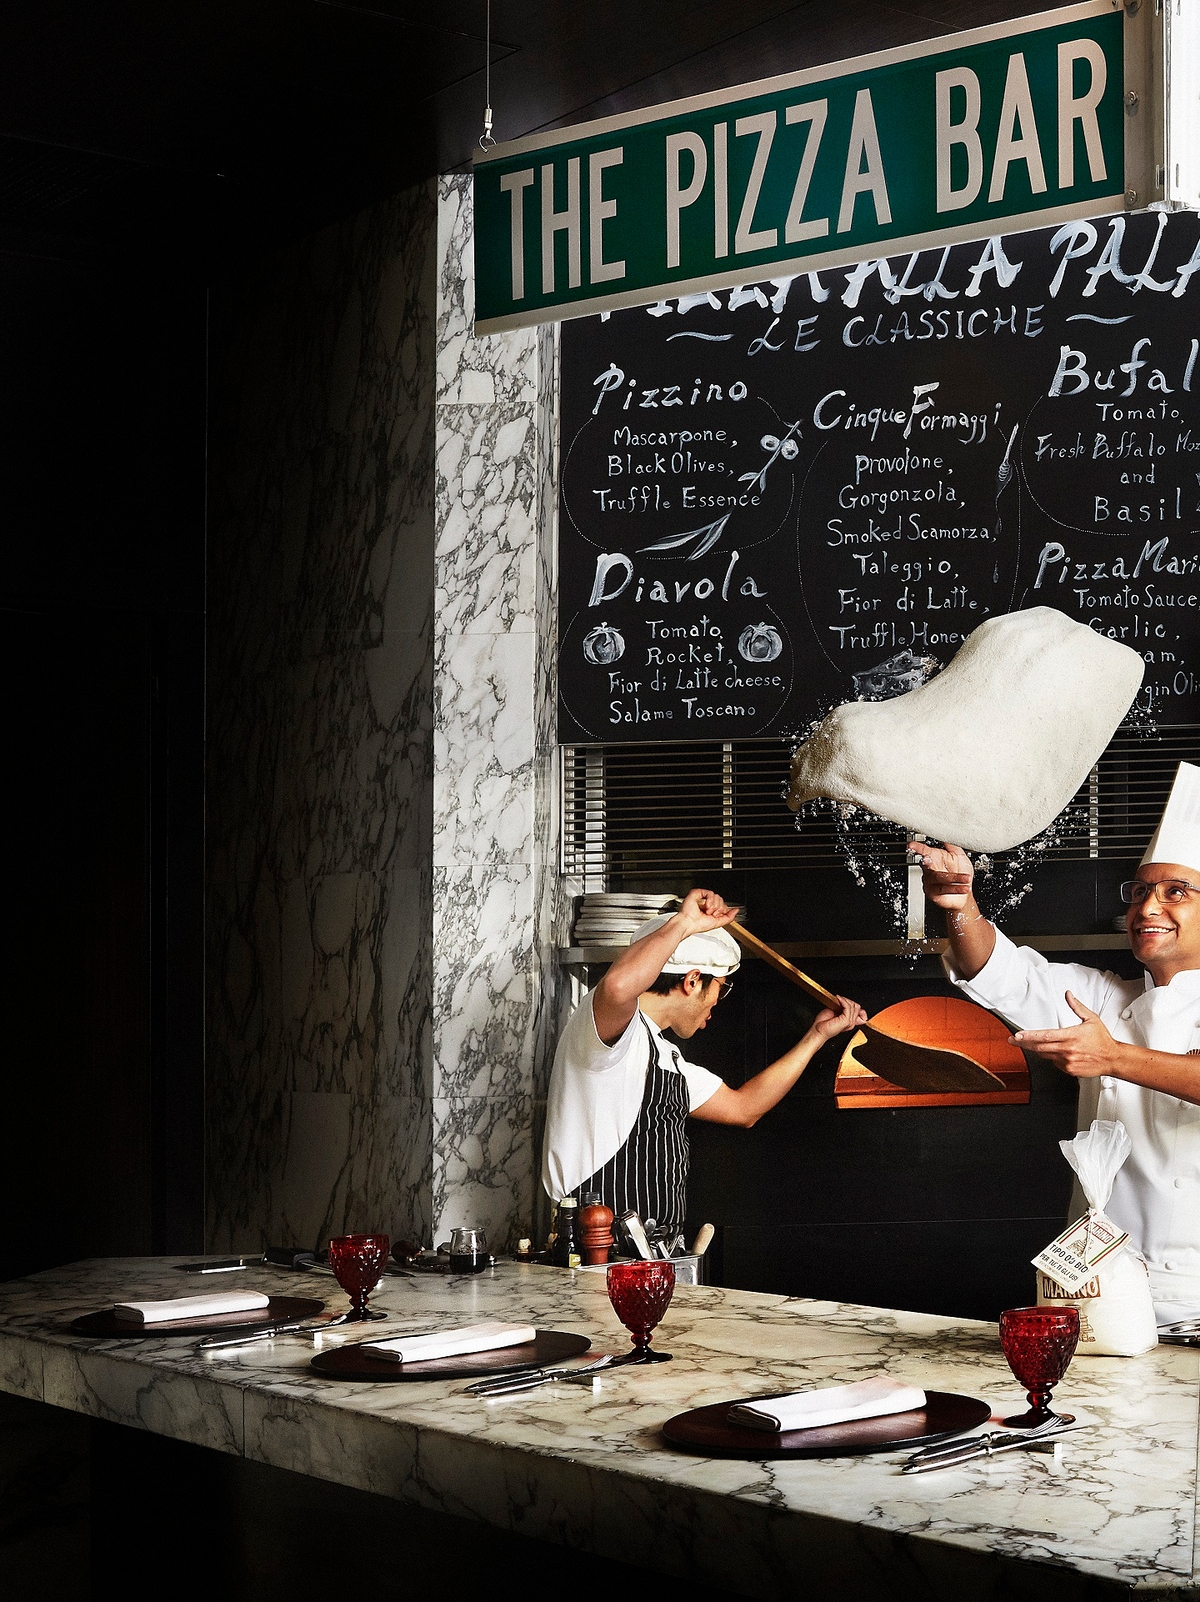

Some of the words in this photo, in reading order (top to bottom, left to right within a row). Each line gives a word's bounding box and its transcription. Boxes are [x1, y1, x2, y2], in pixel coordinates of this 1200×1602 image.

[500, 146, 626, 300] THE
[665, 88, 892, 269] PIZZA
[935, 38, 1107, 214] BAR
[747, 314, 821, 356] LE
[842, 304, 1045, 348] CLASSICHE
[592, 363, 748, 415] Pizzino
[1096, 400, 1185, 424] Tomato,
[613, 426, 738, 452] Mascarpone,
[1034, 432, 1086, 462] Fresh
[1091, 430, 1166, 461] Buffalo
[1120, 463, 1156, 485] and
[592, 486, 671, 513] Truffle
[683, 486, 762, 508] Essence
[838, 481, 966, 514] Gorgonzola,
[1094, 487, 1182, 523] Basil
[826, 515, 902, 547] Smoked
[906, 513, 997, 544] Scamorza,
[588, 550, 768, 607] Diavola
[852, 550, 959, 582] Taleggio,
[1034, 541, 1128, 589] Pizza
[838, 587, 882, 614] Fior
[896, 586, 916, 612] di
[926, 585, 990, 614] Latte,
[1073, 584, 1139, 610] Tomato
[645, 615, 723, 641] Tomato,
[828, 622, 906, 650] Truffle
[645, 643, 735, 668] Rocket,
[608, 671, 643, 694] Fior
[651, 673, 667, 693] di
[676, 668, 718, 690] Latte
[725, 664, 786, 694] cheese,
[608, 698, 674, 723] Salame
[681, 697, 756, 720] Toscano
[1039, 1252, 1049, 1263] PER
[1049, 1244, 1066, 1258] TIPO
[1074, 1260, 1089, 1274] BIO
